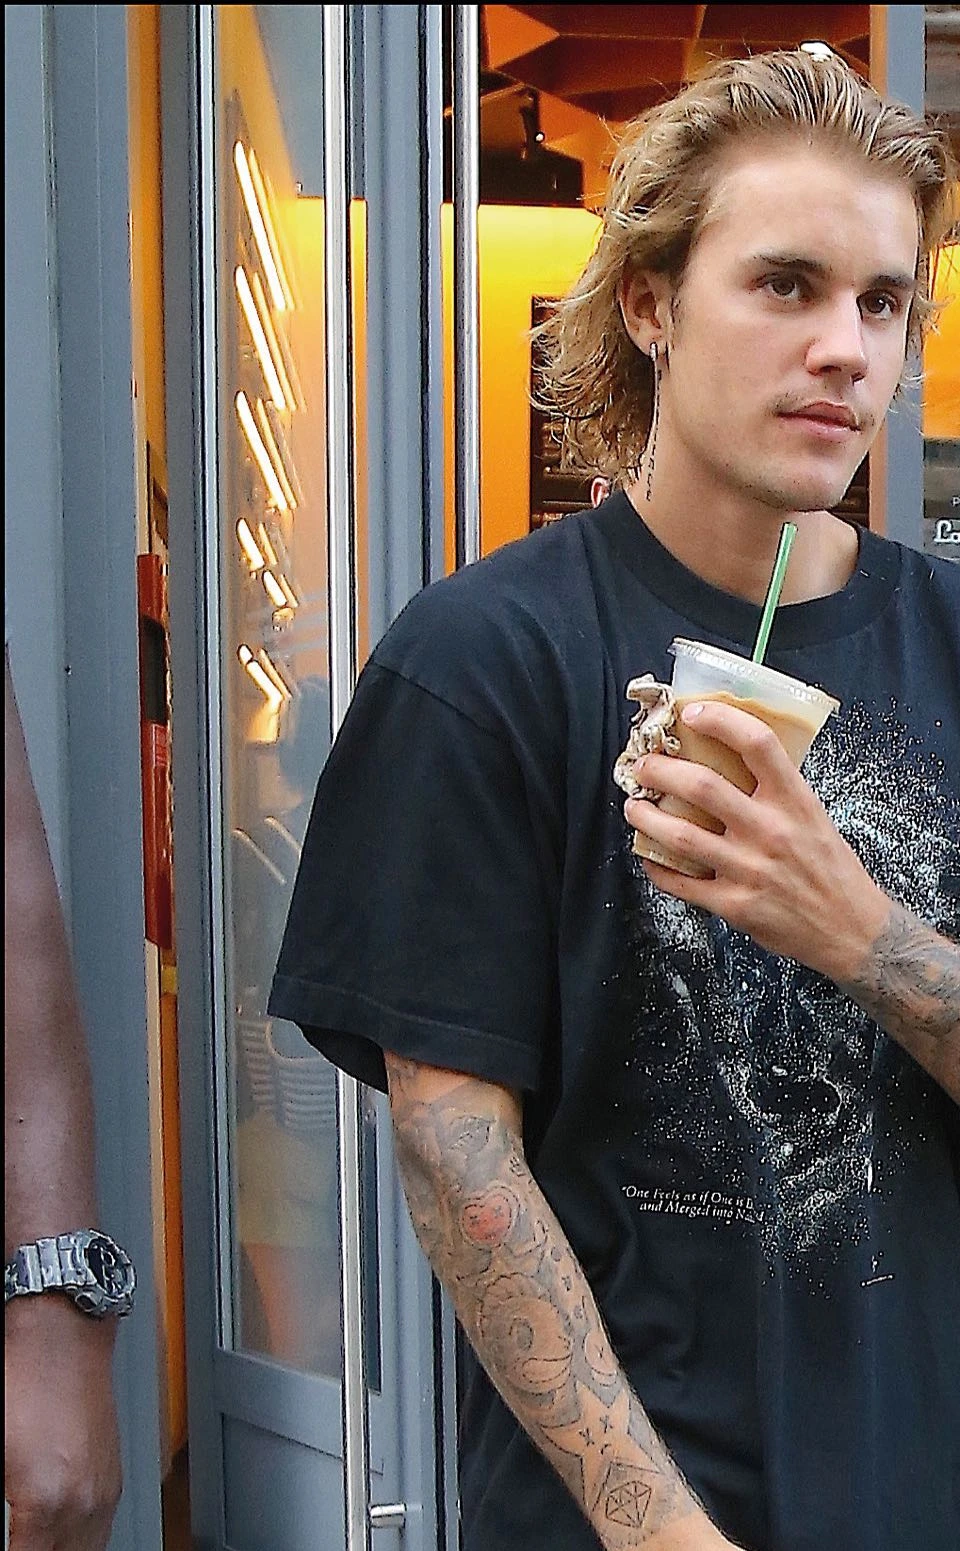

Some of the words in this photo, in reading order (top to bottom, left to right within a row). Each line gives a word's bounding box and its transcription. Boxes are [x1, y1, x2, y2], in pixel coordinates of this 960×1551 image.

[683, 1191, 697, 1201] as
[699, 1190, 710, 1206] if
[711, 1192, 733, 1205] One
[639, 1200, 663, 1212] and
[664, 1200, 711, 1218] Merged
[712, 1205, 734, 1218] into
